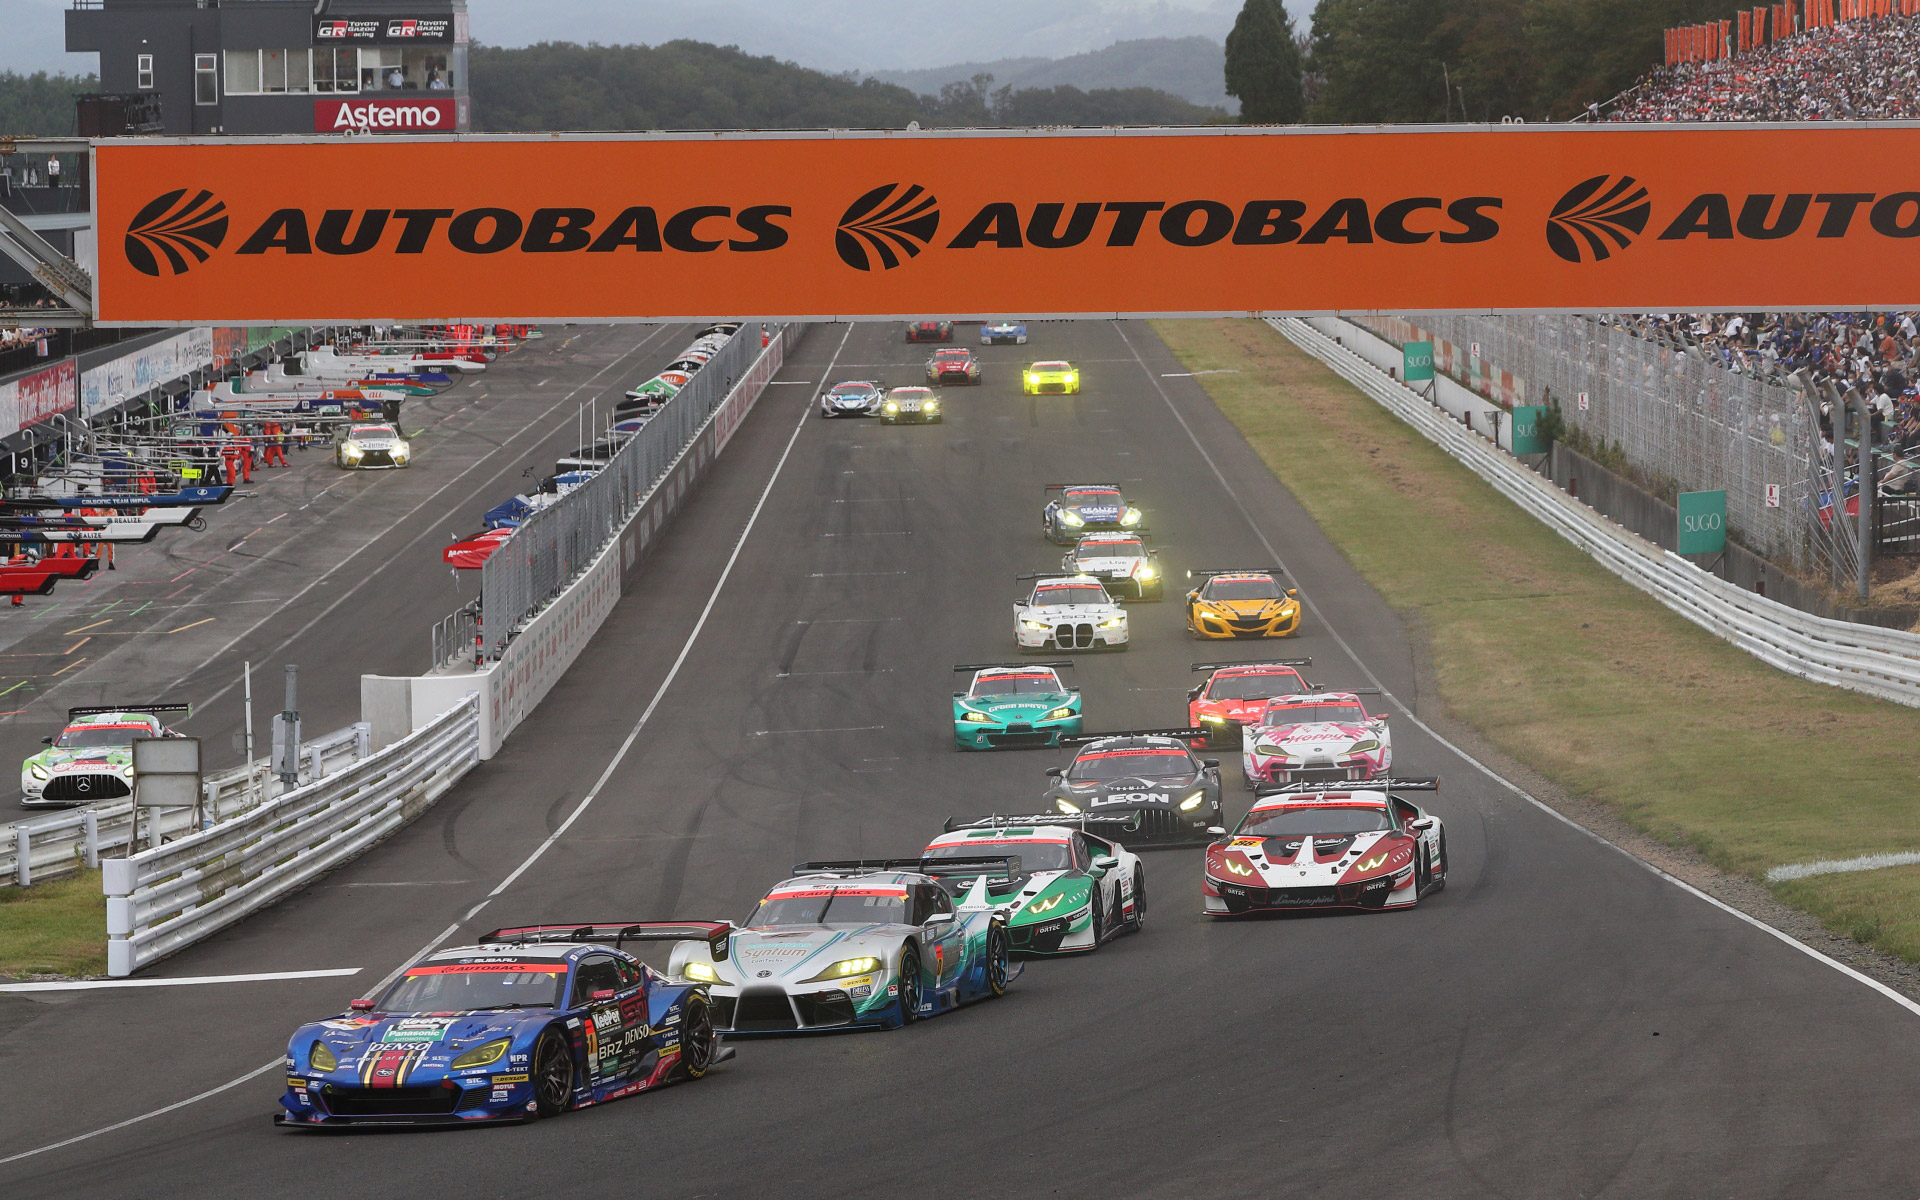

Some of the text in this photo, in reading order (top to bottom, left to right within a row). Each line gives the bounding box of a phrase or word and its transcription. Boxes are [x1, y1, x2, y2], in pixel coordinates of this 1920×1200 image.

[319, 26, 346, 37] GR
[388, 25, 416, 36] GR
[334, 103, 441, 128] Astemo
[945, 197, 1503, 249] AUTOBACS
[235, 205, 792, 255] AUTOBACS
[1408, 355, 1431, 367] SUGO
[128, 416, 140, 426] 13
[1517, 424, 1537, 438] SUG
[20, 458, 28, 468] 9
[1685, 512, 1720, 532] SUGO
[1290, 733, 1346, 744] Hoppy
[1090, 793, 1169, 808] LEON
[741, 948, 808, 959] Syntium
[592, 1009, 620, 1029] KeePer
[624, 1024, 649, 1046] DENSO
[370, 1042, 430, 1051] DENSO
[599, 1040, 623, 1060] BRZ
[510, 1054, 528, 1062] NPR
